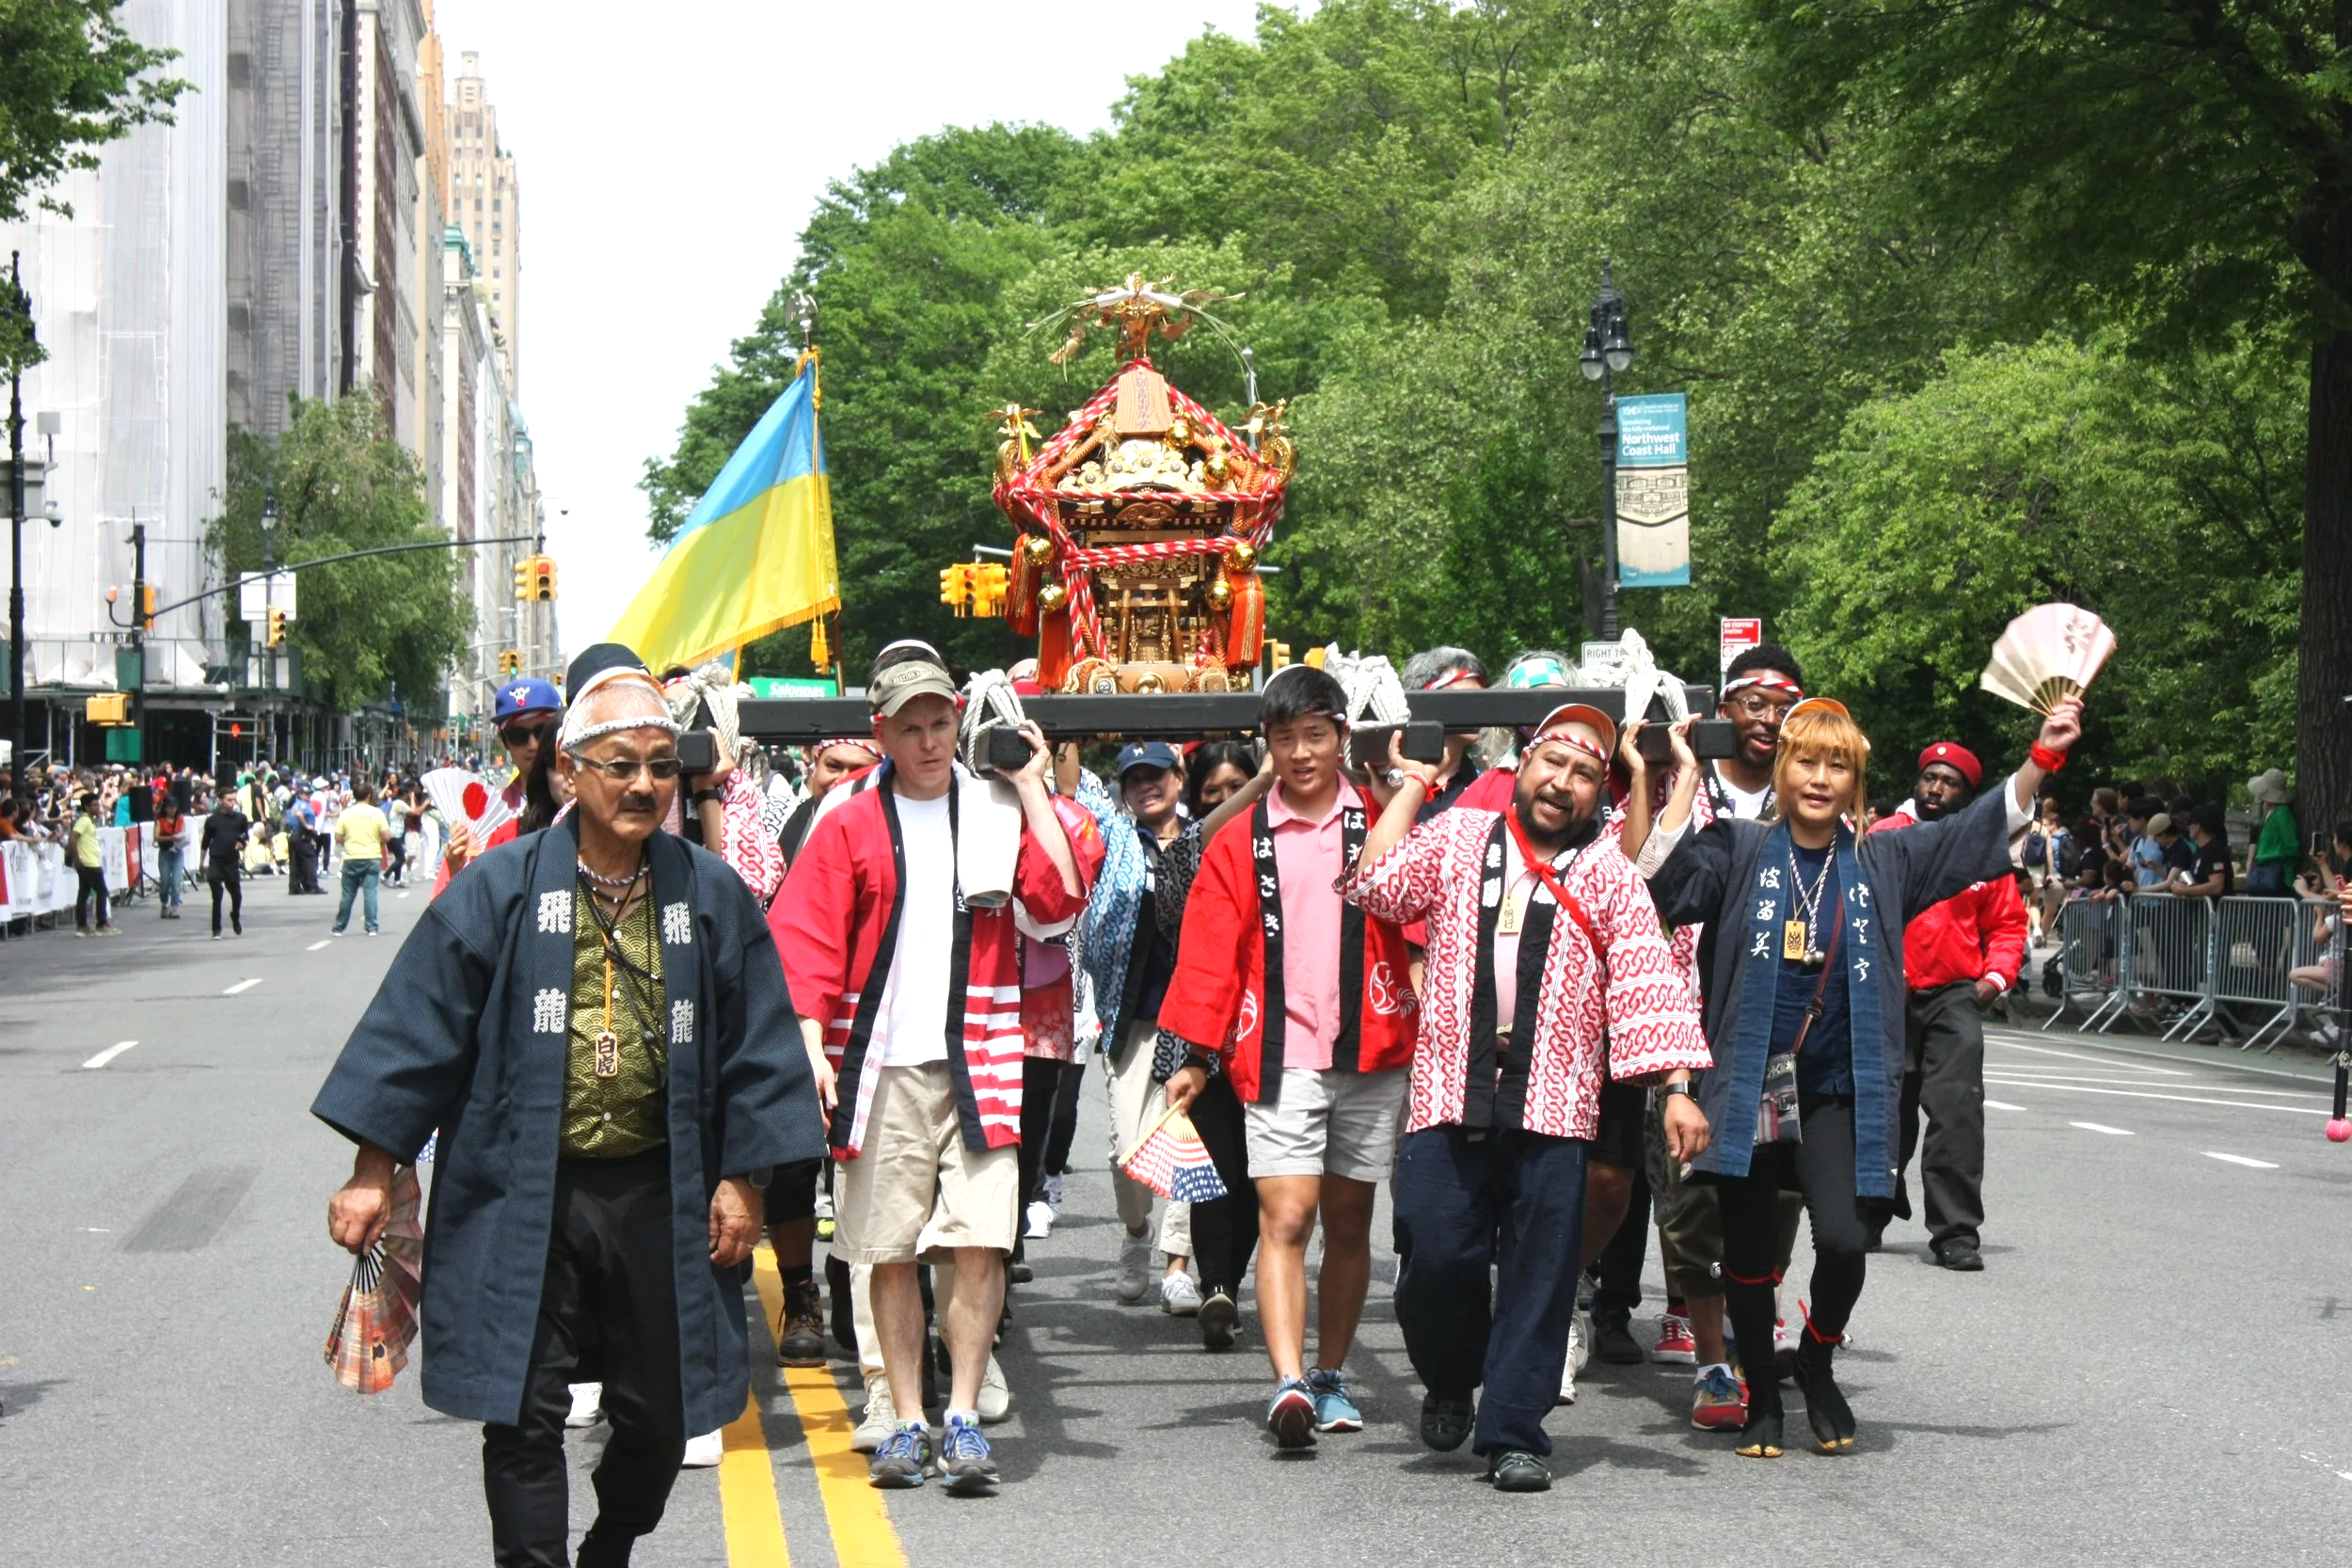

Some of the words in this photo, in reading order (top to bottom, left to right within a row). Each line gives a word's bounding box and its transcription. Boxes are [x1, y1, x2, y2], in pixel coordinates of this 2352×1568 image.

[1623, 432, 1680, 444] Northwest
[1622, 445, 1652, 456] Coast
[1654, 443, 1676, 454] Hall
[117, 633, 128, 643] ST
[1587, 649, 1611, 658] RIGHT
[769, 682, 825, 697] Salonpas
[596, 1035, 616, 1074] 白虎
